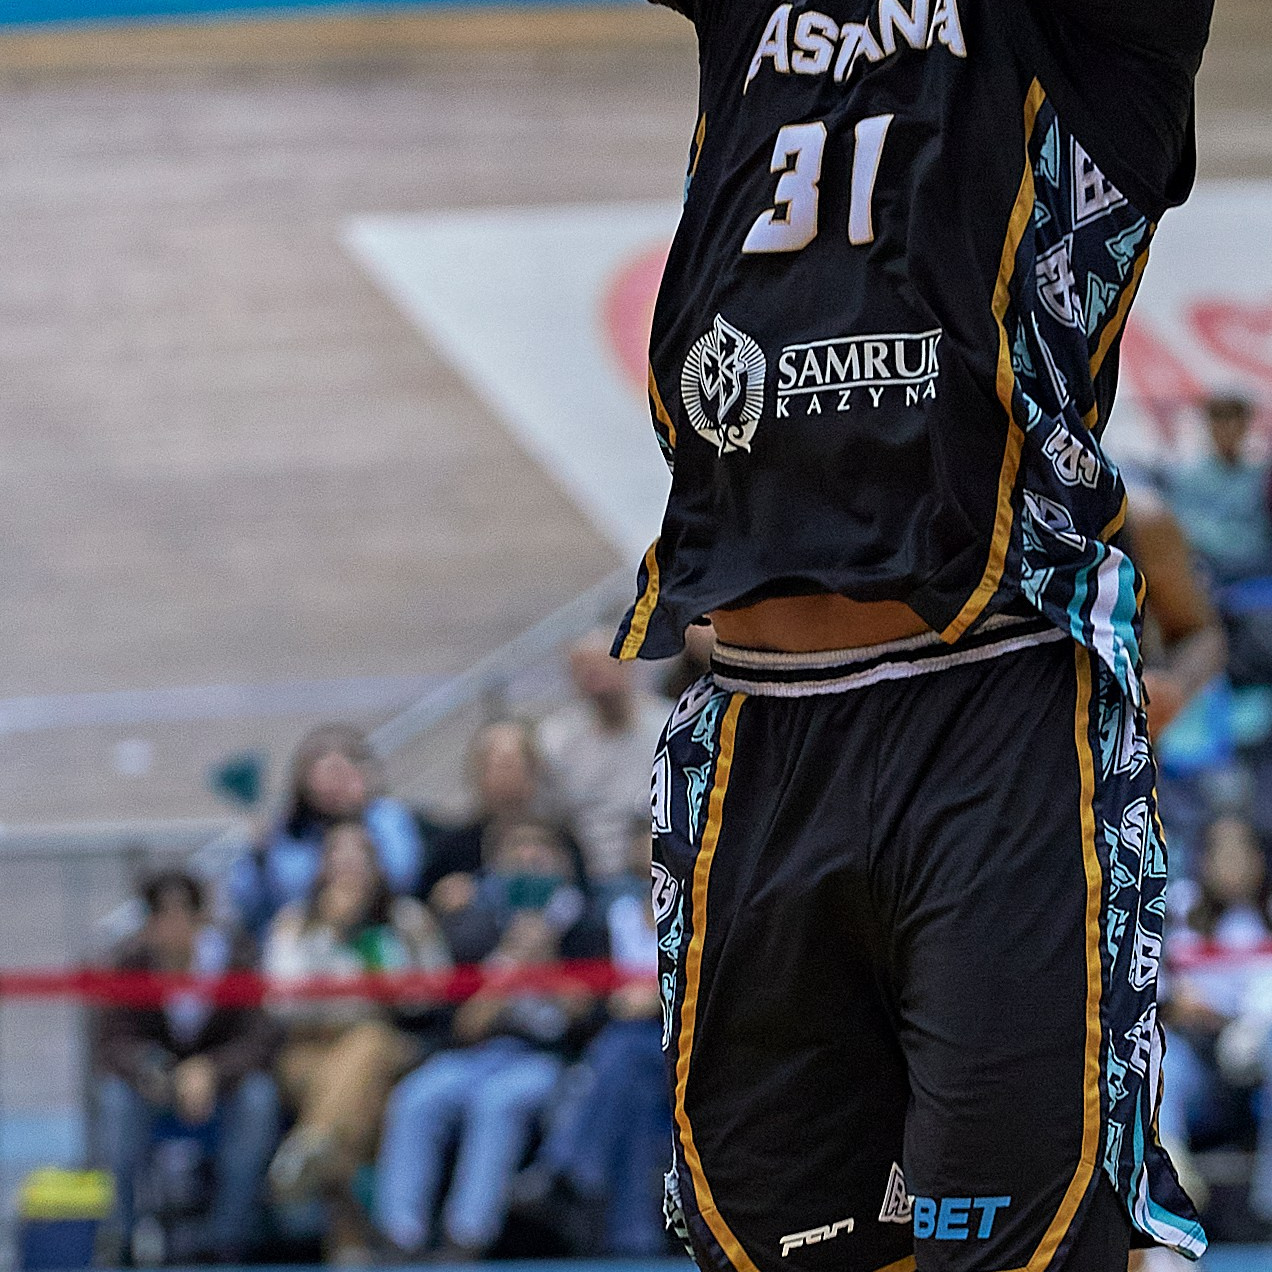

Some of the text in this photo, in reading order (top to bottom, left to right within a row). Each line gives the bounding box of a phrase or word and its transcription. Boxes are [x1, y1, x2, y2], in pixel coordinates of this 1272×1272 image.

[742, 113, 895, 254] 31
[777, 334, 942, 390] SAMRUK
[776, 382, 938, 420] KAZYNA
[907, 1195, 1012, 1241] BET
